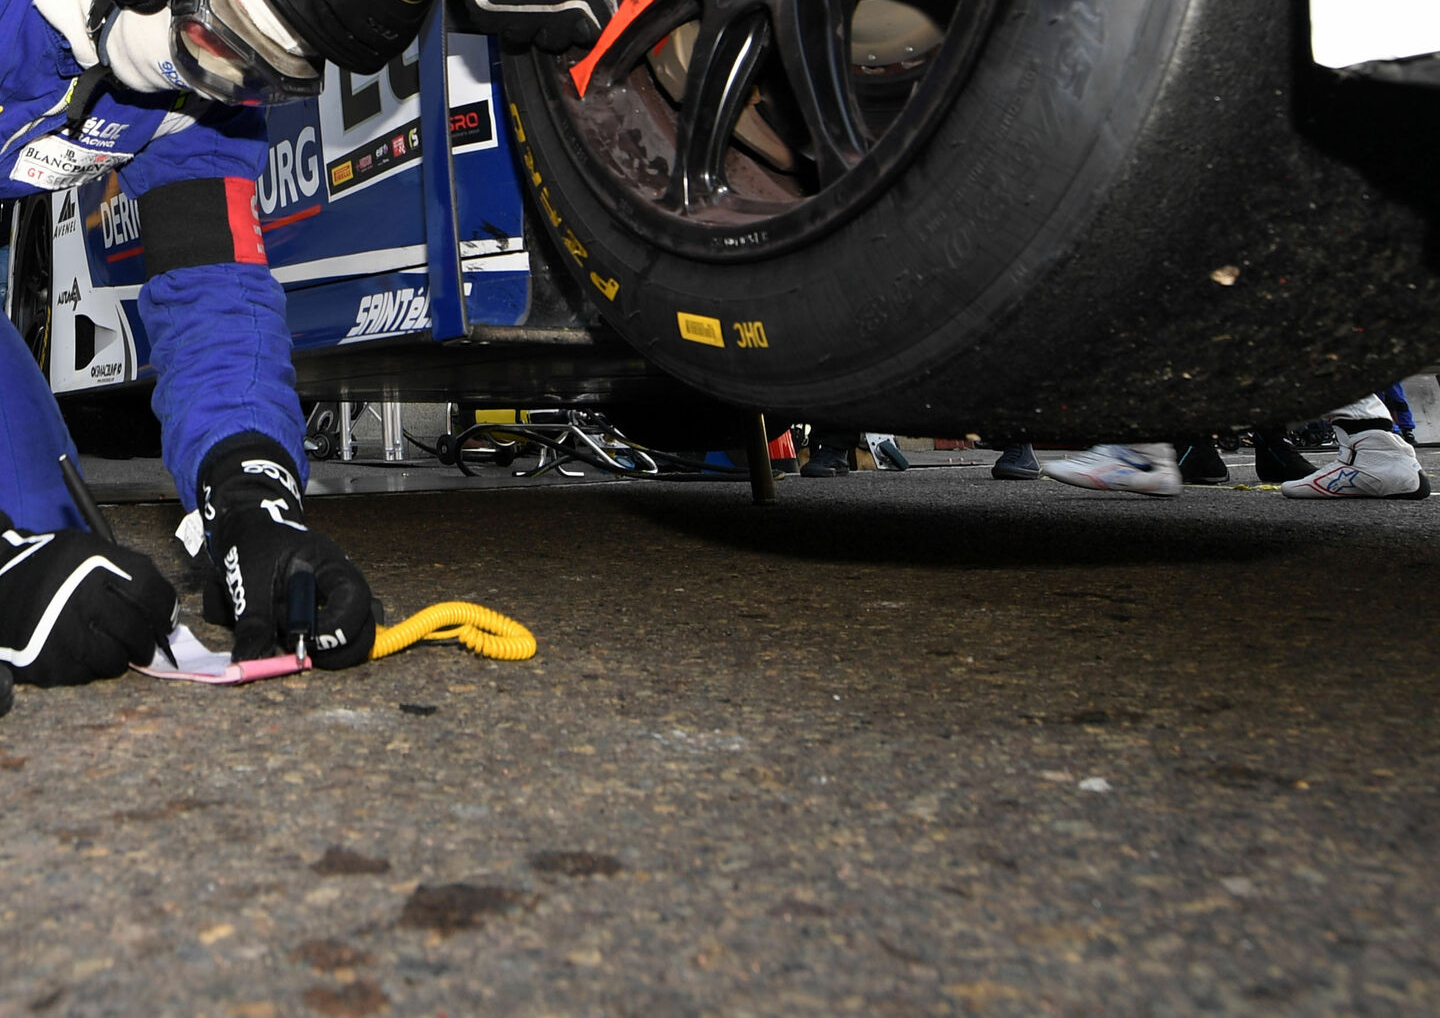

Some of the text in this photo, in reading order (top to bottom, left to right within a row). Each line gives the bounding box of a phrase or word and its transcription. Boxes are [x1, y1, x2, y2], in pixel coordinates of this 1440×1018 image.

[27, 167, 45, 181] GT
[53, 220, 77, 239] AVENEL
[733, 321, 769, 348] DHC
